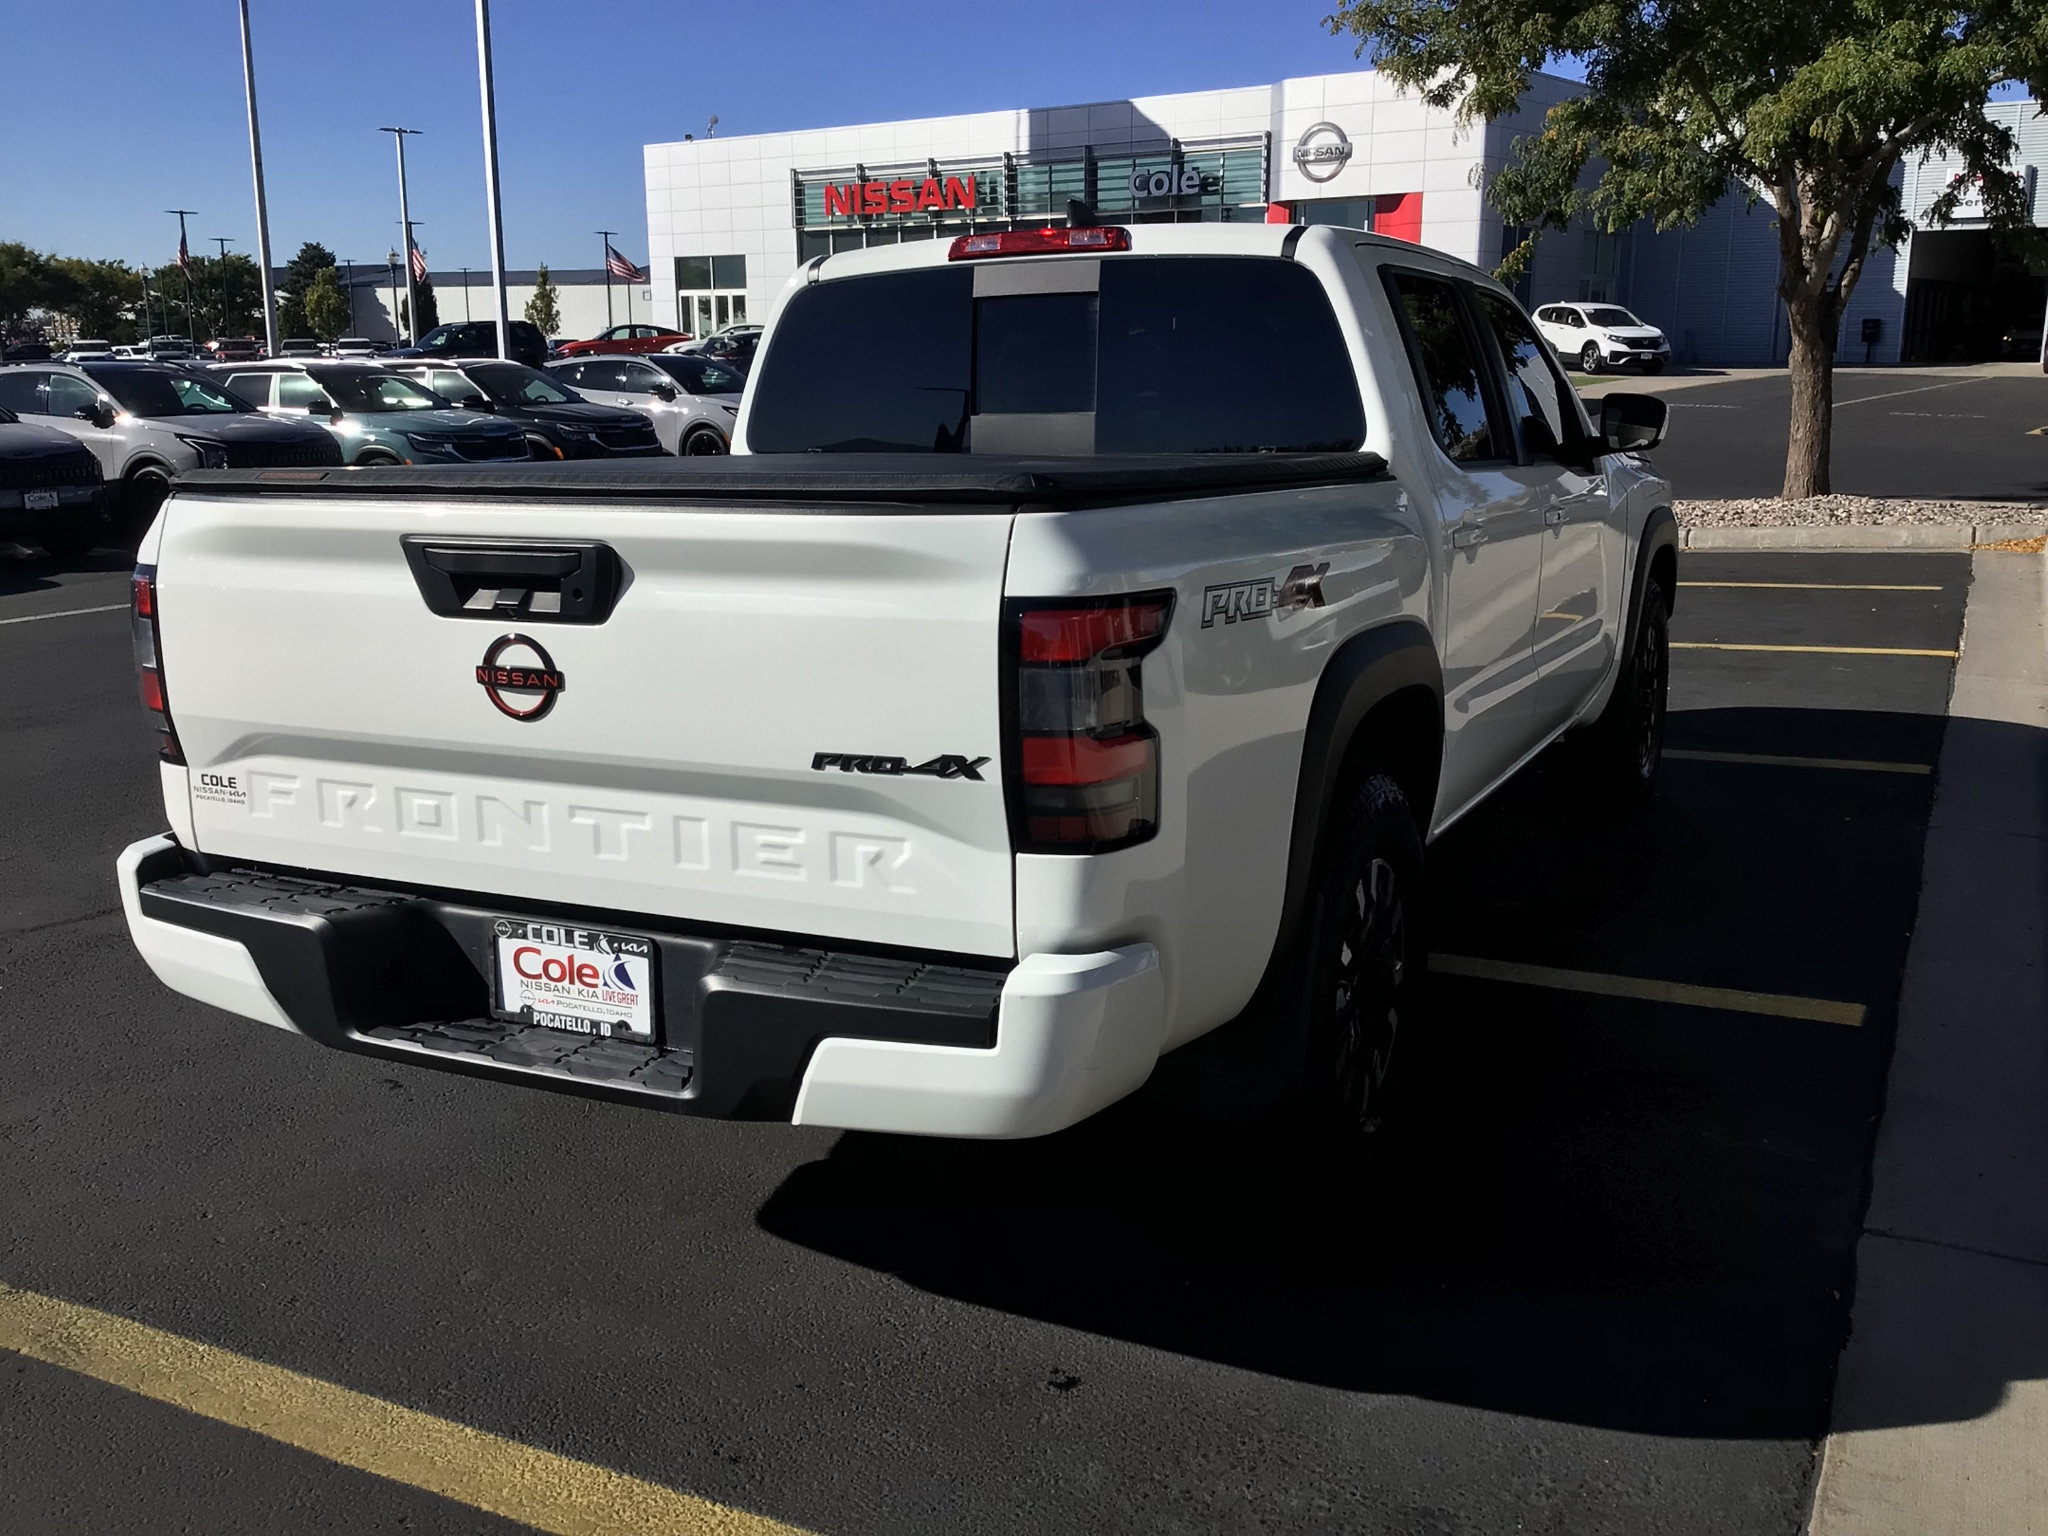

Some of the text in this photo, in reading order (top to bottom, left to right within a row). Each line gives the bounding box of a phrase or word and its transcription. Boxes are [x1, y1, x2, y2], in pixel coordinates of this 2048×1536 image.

[1297, 146, 1345, 159] NISSAN
[1128, 164, 1200, 198] Cole
[824, 173, 976, 216] NISSAN
[477, 668, 558, 687] NISSAN
[201, 774, 237, 789] COLE
[245, 769, 917, 894] FRONTIER
[527, 923, 590, 949] COLE
[513, 946, 600, 989] Cole
[520, 979, 600, 1000] NISSAN KIA
[606, 1008, 633, 1018] IDAHO
[600, 1022, 612, 1037] ID
